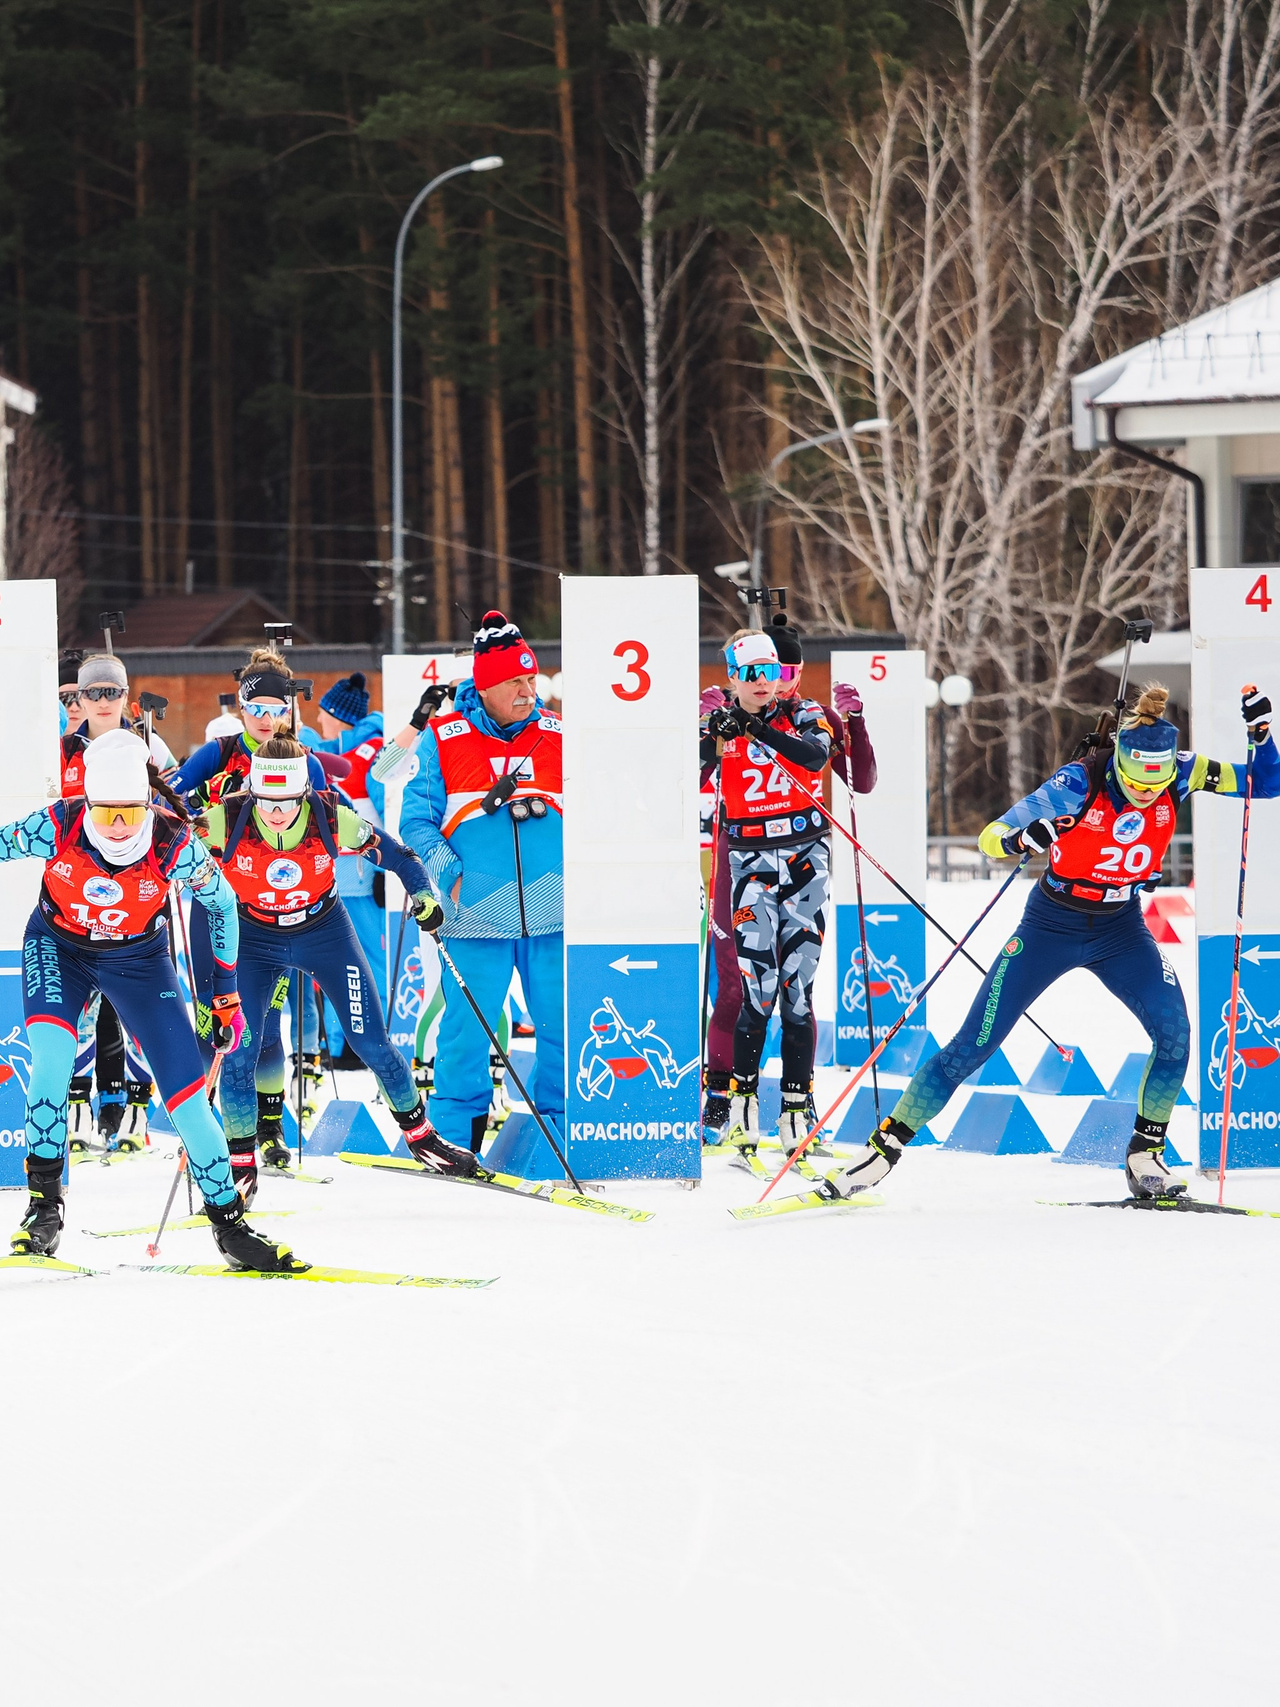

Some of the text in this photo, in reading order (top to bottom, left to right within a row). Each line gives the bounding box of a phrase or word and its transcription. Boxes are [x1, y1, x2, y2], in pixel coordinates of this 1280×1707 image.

[1245, 574, 1272, 612] 4
[422, 659, 440, 685] 4
[611, 640, 651, 701] 3
[870, 655, 887, 681] 5
[444, 722, 463, 736] 35
[742, 764, 792, 802] 24
[1094, 844, 1152, 874] 20
[24, 939, 41, 998] ОБЛАСТЬ
[41, 935, 63, 1004] ЮМЕНСКАЯ
[438, 942, 466, 988] barnett
[346, 965, 363, 1015] BEEU
[267, 1096, 280, 1104] 173
[570, 1121, 698, 1141] КРАСНОЯРСК
[1148, 1125, 1162, 1133] 170
[567, 1195, 630, 1217] FISCHER
